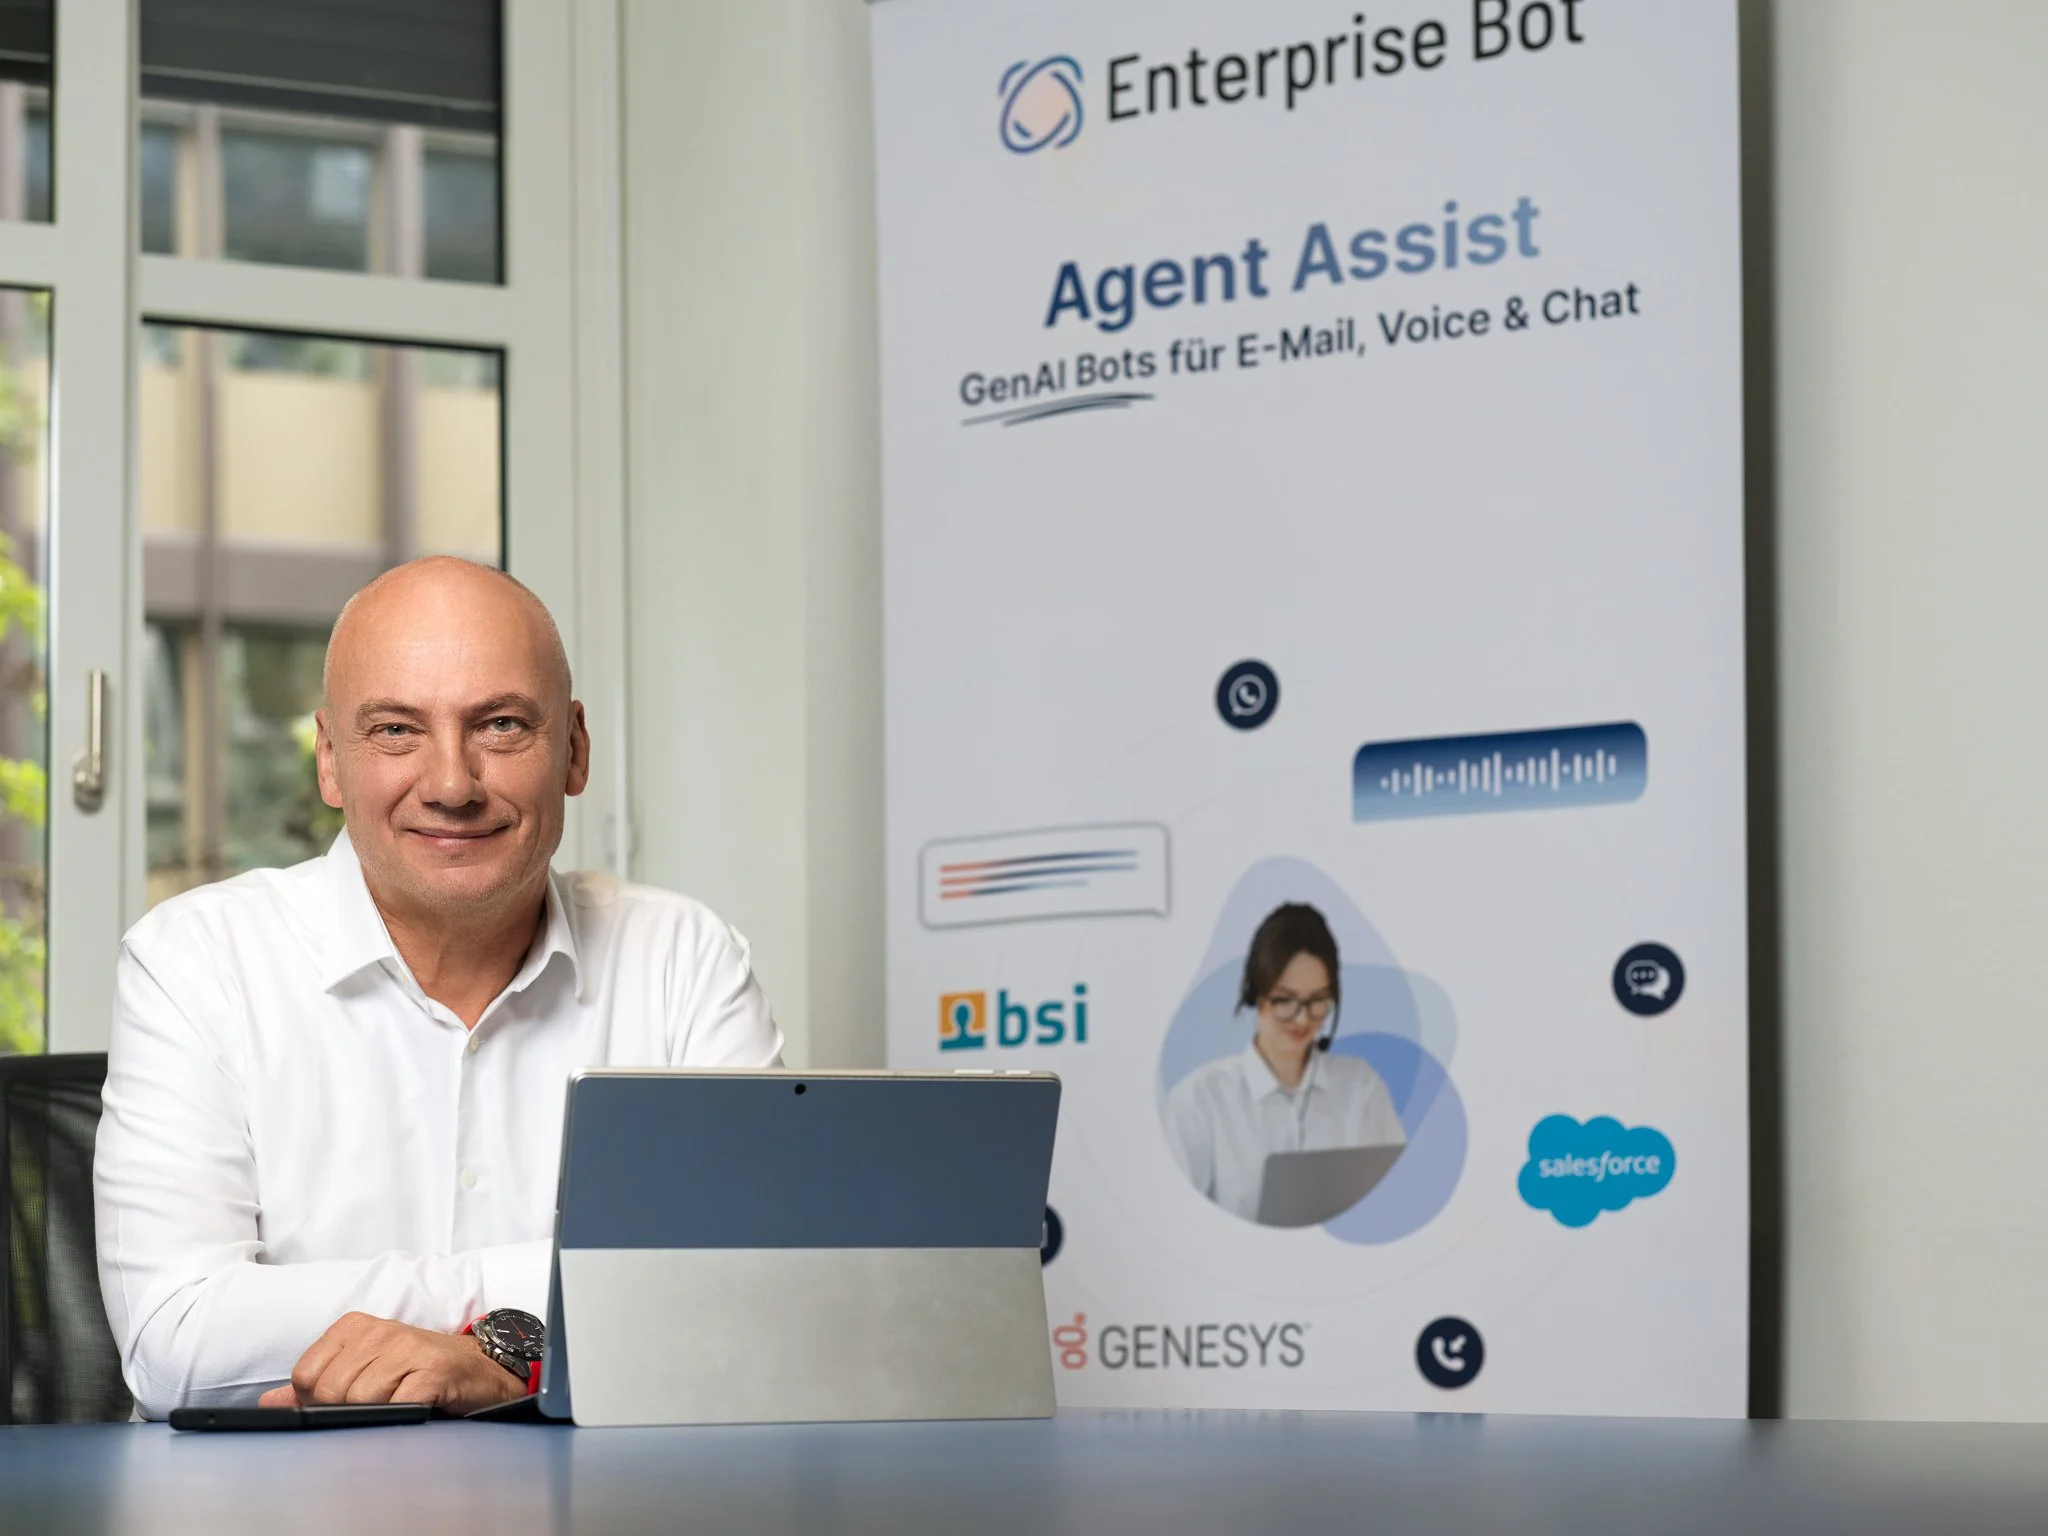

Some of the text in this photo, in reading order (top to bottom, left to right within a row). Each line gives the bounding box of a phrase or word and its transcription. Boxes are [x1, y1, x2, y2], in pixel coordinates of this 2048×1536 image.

[1108, 0, 1585, 122] Enterprise Bot
[1044, 197, 1540, 334] Agent Assist
[960, 282, 1640, 406] GenAI Bots für E-Mail, Voice & Chat
[997, 982, 1088, 1047] bsi
[1539, 1150, 1661, 1183] salesforce
[1098, 1322, 1305, 1370] GENESYS
